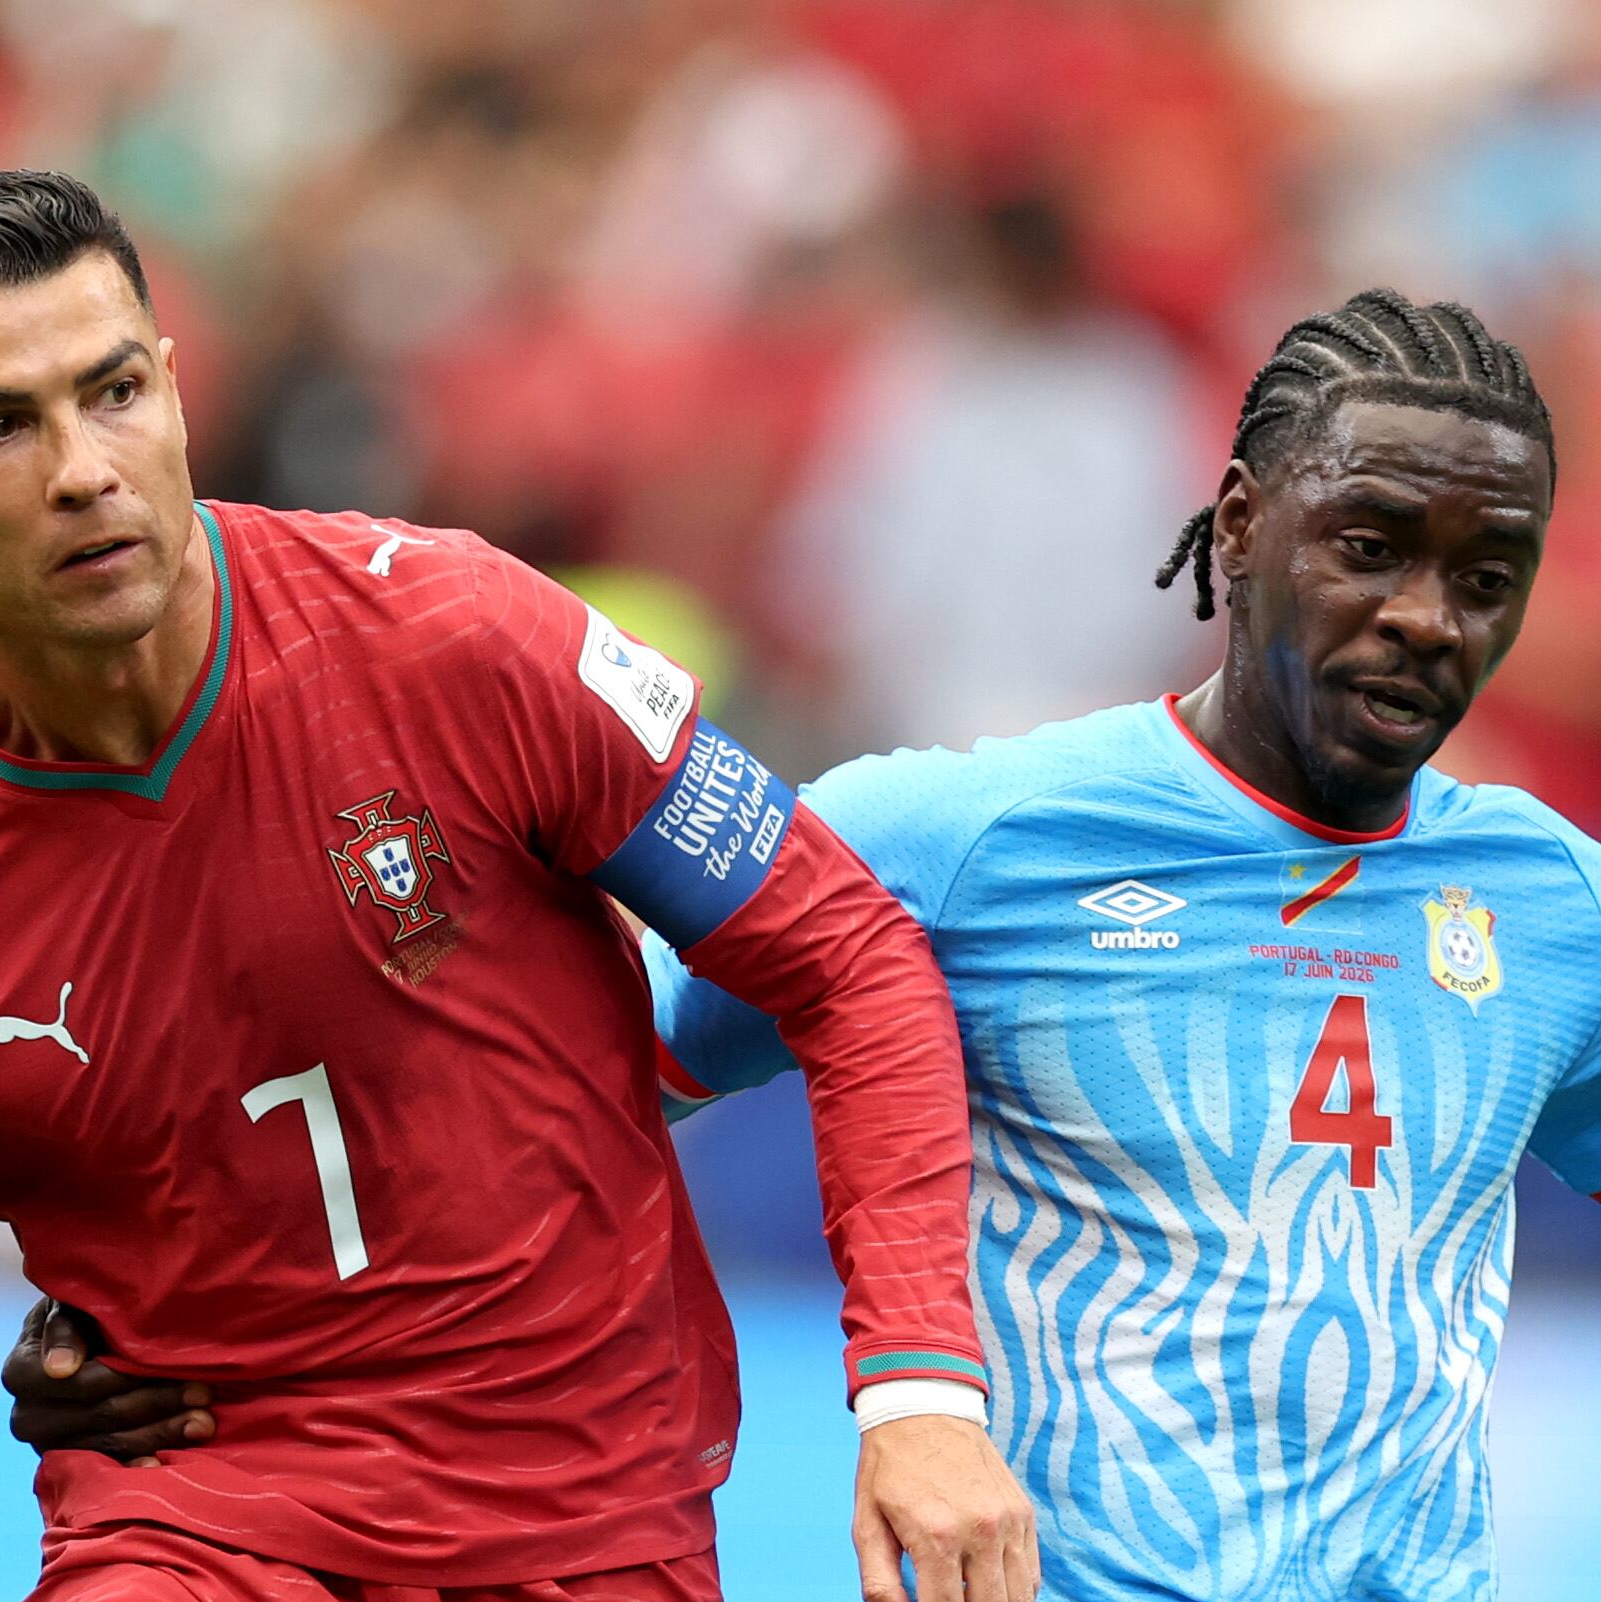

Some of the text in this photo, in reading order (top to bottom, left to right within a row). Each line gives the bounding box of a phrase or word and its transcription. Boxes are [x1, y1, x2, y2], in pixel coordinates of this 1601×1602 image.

[663, 694, 680, 720] FIFA
[653, 731, 717, 840] FOOTBALL
[673, 740, 745, 856] UNITES
[703, 755, 772, 880] the World
[752, 808, 783, 861] FIFA
[1090, 926, 1180, 949] umbro
[1249, 945, 1324, 962] PORTUGAL
[1335, 949, 1352, 964] RD
[1354, 951, 1399, 969] CONGO
[1284, 962, 1374, 983] 17 JUIN 2026
[1442, 971, 1491, 992] FECOFA
[1289, 993, 1393, 1190] 4
[240, 1061, 370, 1281] 7
